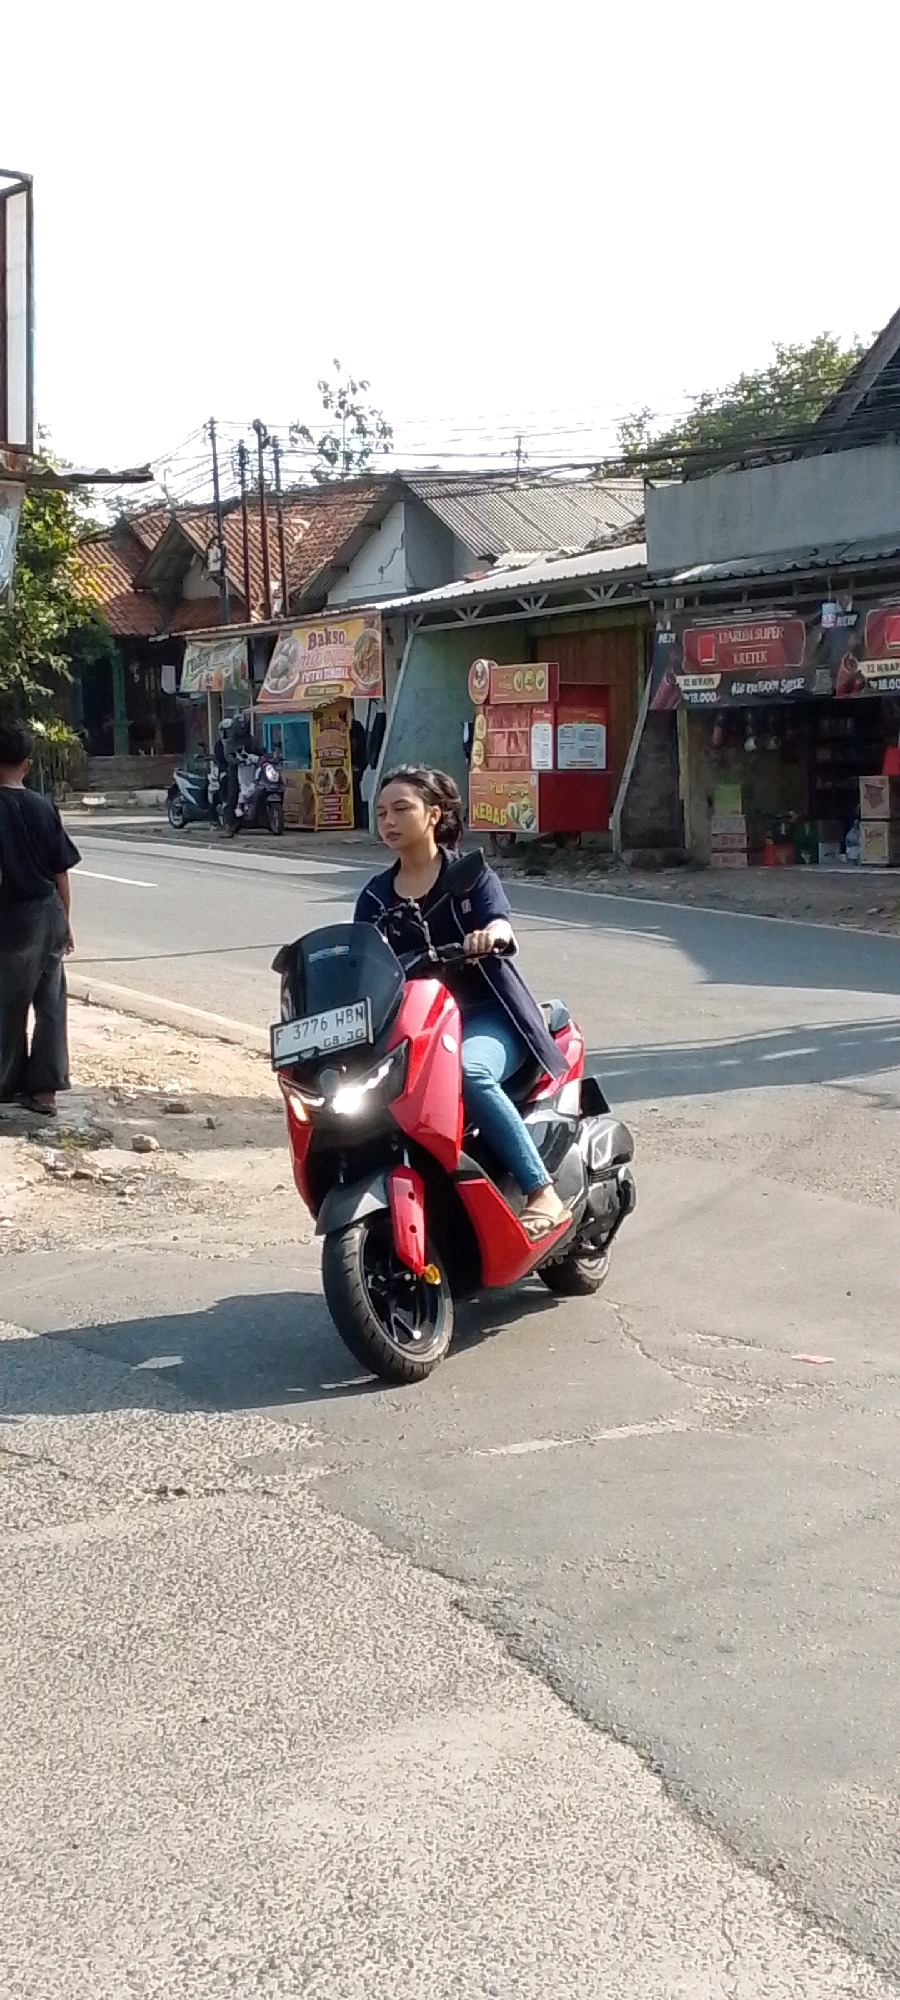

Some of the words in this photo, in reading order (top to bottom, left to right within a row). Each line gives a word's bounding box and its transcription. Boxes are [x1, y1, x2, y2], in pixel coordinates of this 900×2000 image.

[307, 626, 346, 651] Bakso
[472, 801, 507, 827] KEBAB
[275, 1028, 284, 1046] F
[293, 1016, 328, 1040] 3776
